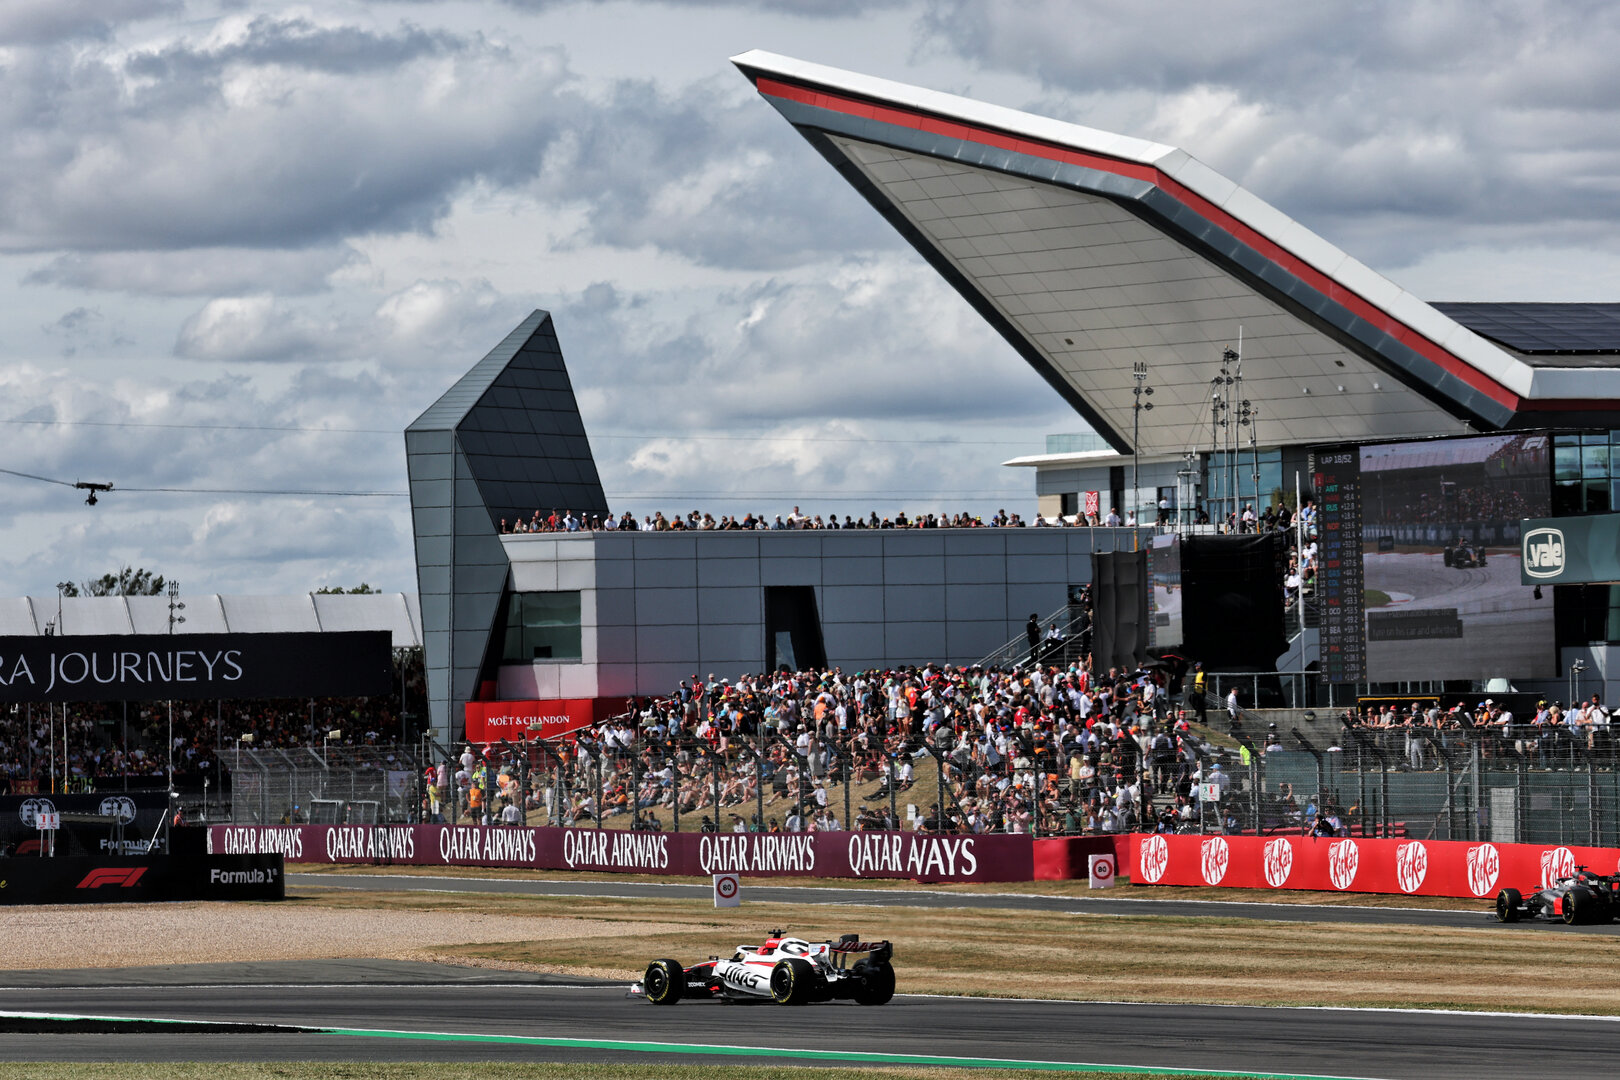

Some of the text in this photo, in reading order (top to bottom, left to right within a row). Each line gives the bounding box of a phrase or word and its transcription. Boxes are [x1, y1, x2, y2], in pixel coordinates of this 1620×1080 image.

[1321, 454, 1352, 465] LAP 18/52
[1325, 484, 1338, 493] ANT
[1325, 503, 1338, 512] RUS
[1530, 534, 1562, 567] vale
[1328, 607, 1341, 615] OCO
[1329, 626, 1342, 634] BEA
[45, 651, 243, 693] JOURNEYS
[488, 715, 570, 726] MOËT & CHANDON
[225, 828, 256, 854] QATAR
[259, 828, 303, 859] AIRWAYS
[327, 827, 414, 861] QATAR AIRWAYS
[439, 827, 536, 863] QATAR AIRWAYS
[563, 830, 669, 869] QATAR AIRWAYS
[699, 835, 815, 874] QATAR AIRWAYS
[848, 834, 903, 873] QATAR
[1144, 836, 1167, 882] KitKat
[1205, 838, 1228, 884] KitKat
[211, 868, 264, 884] Formula
[1268, 839, 1291, 886] KitKat
[1332, 840, 1357, 887] KitKat
[1401, 842, 1426, 890] KitKat
[1471, 844, 1498, 894] KitKat
